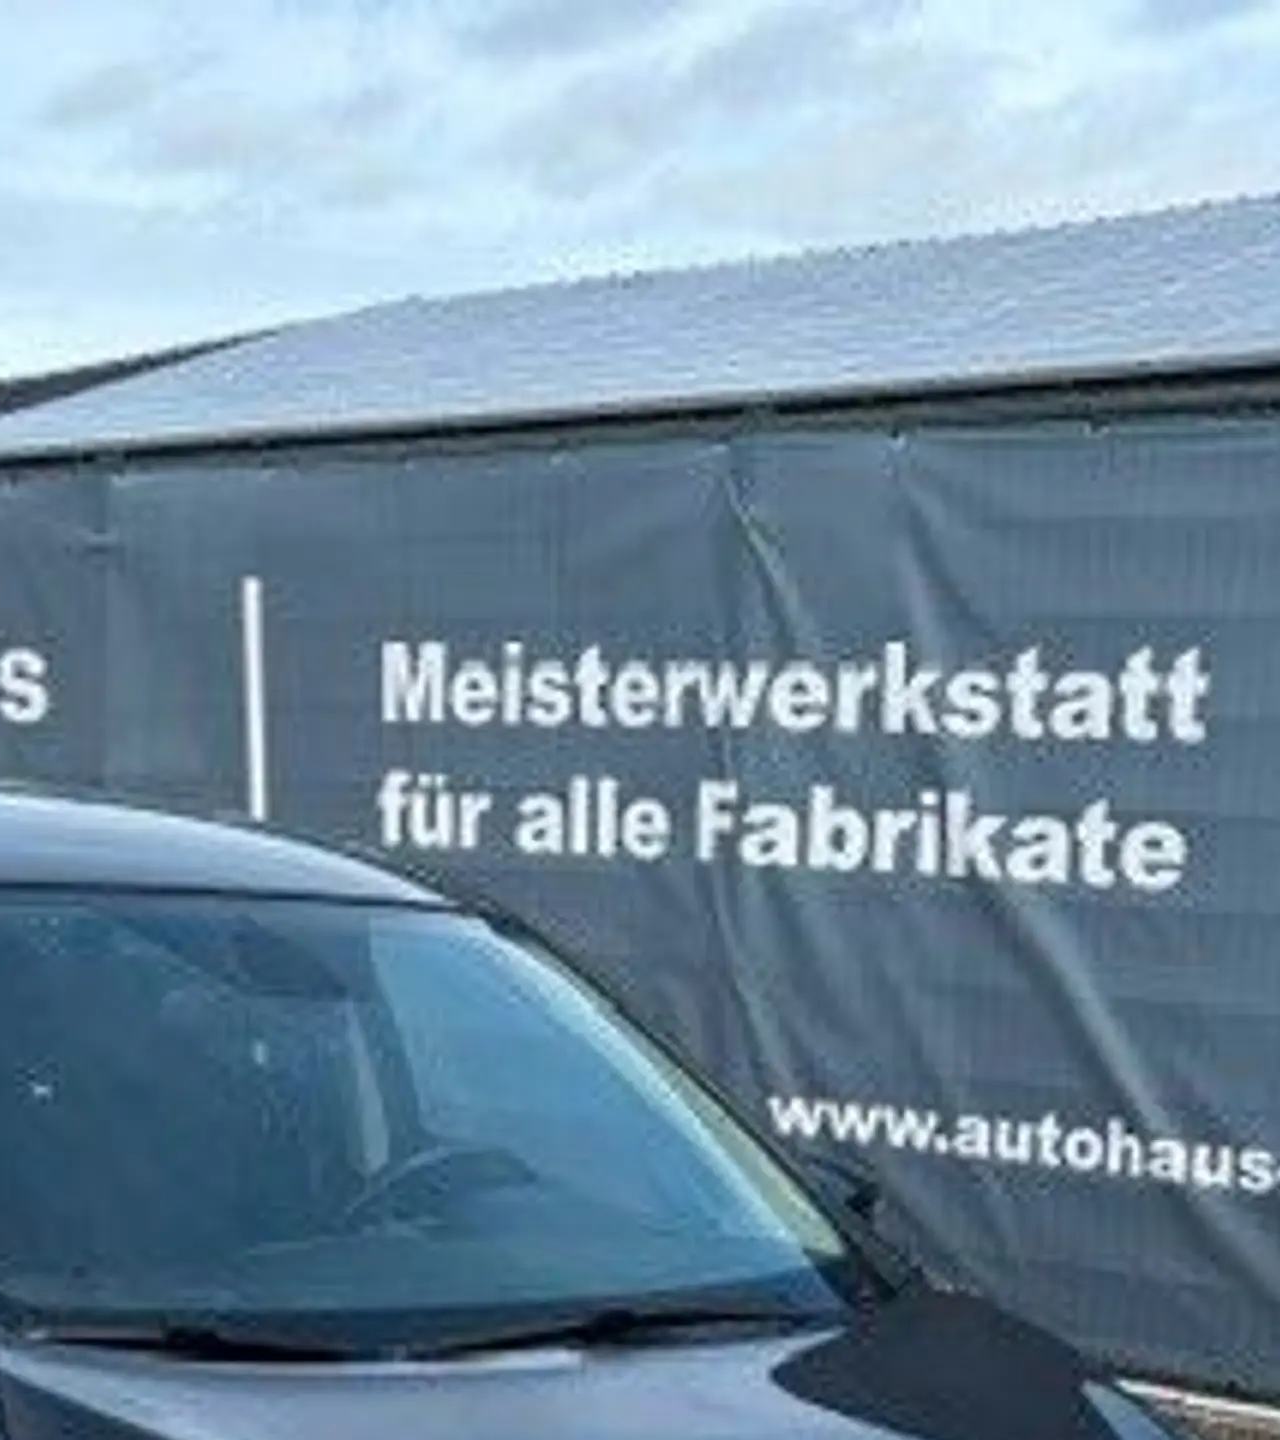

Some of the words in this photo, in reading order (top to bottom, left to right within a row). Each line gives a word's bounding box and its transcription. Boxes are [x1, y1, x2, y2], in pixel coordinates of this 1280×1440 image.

[379, 640, 1211, 742] Meisterwerkstatt
[376, 770, 492, 850] für
[517, 776, 672, 861] alle
[695, 780, 1190, 891] Fabrikate
